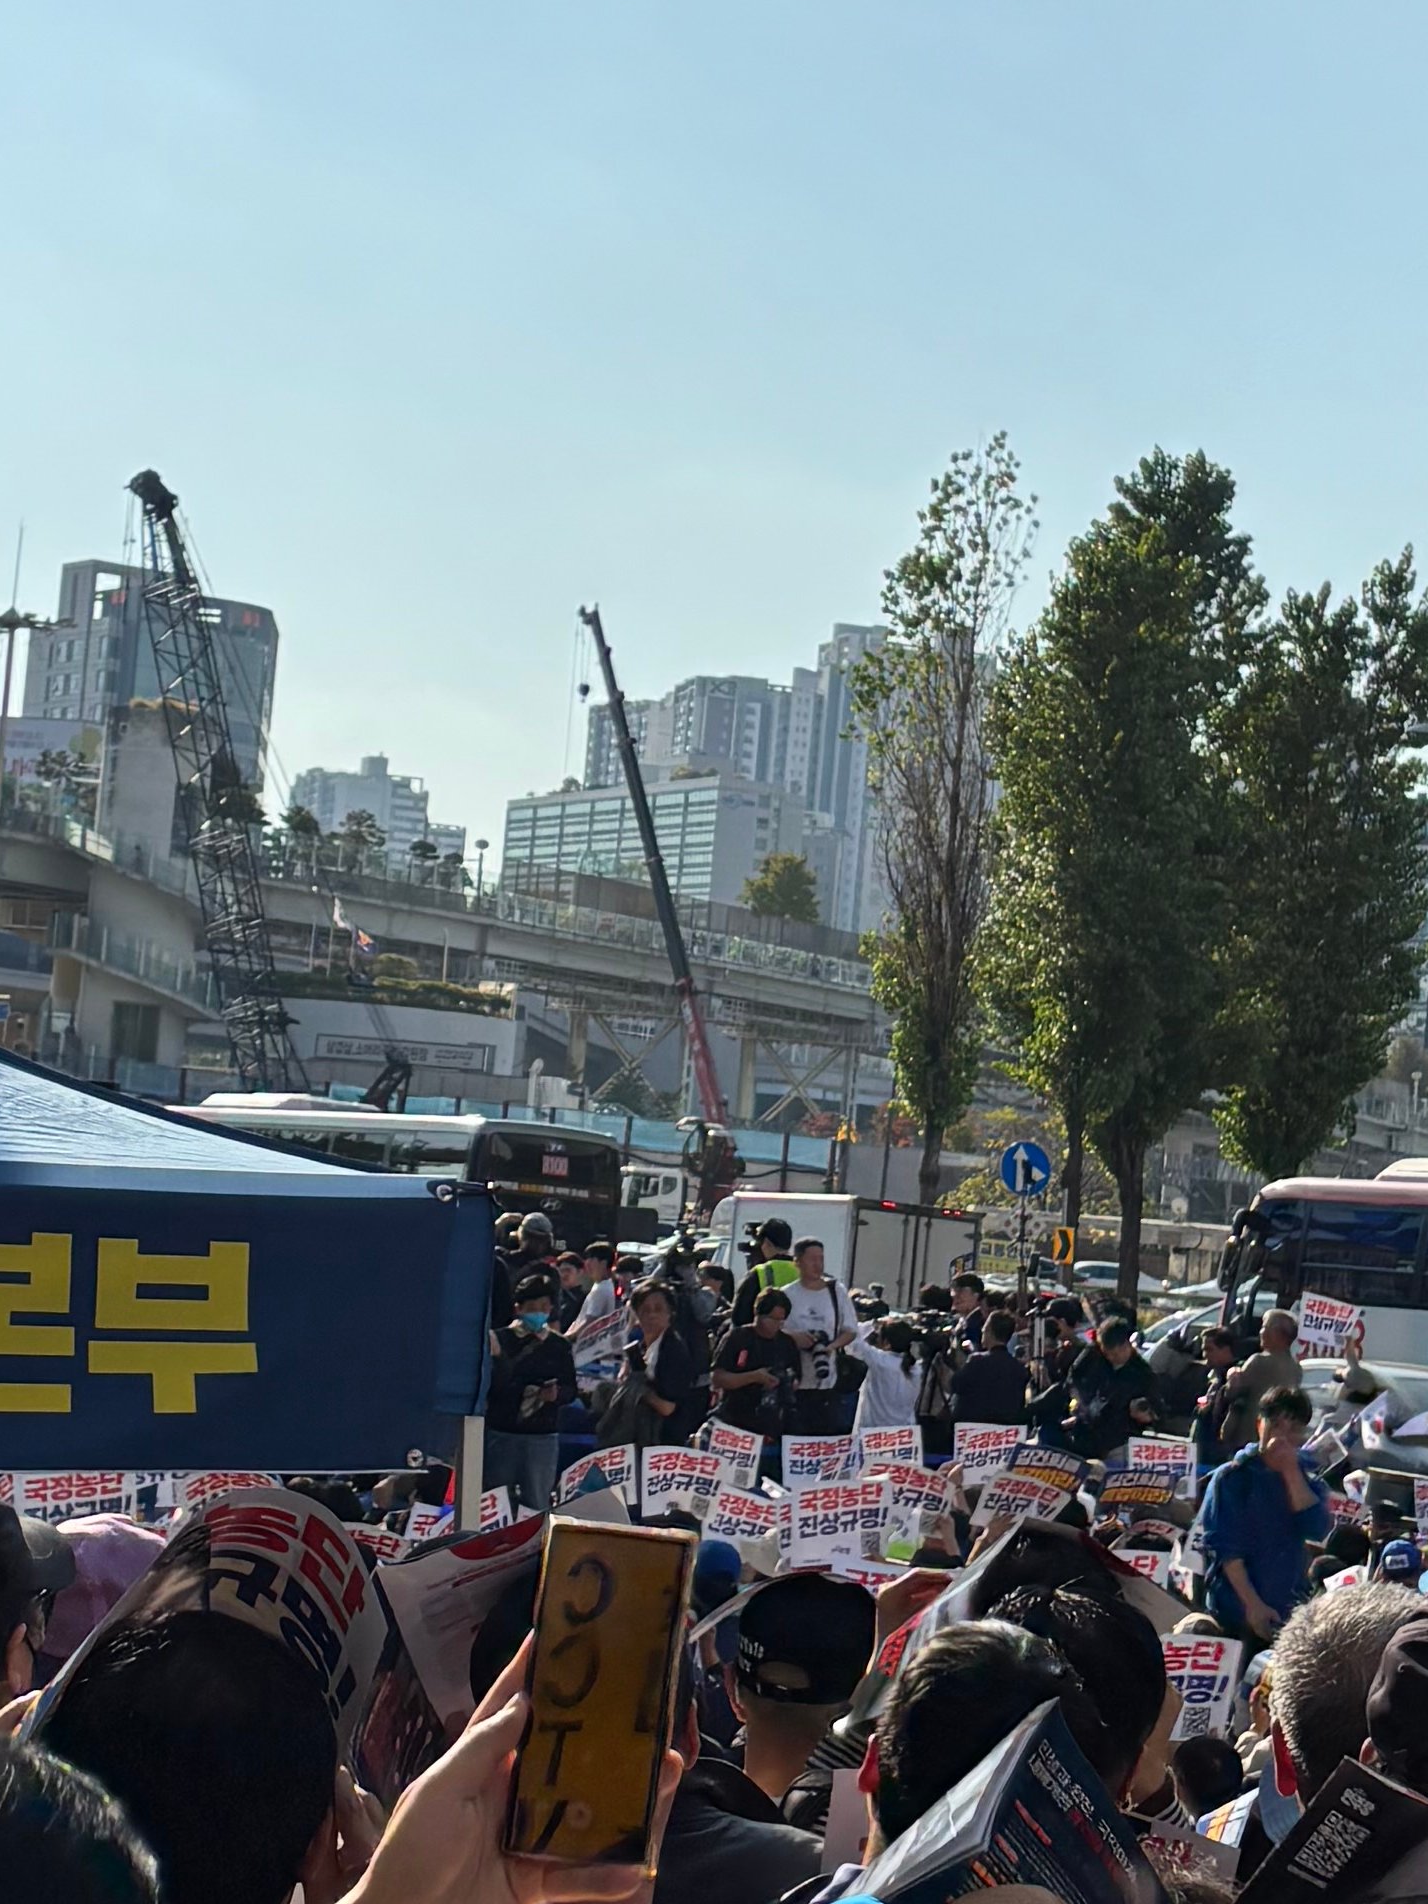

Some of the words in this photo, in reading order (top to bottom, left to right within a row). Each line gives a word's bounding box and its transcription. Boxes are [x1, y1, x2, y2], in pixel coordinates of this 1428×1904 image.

[649, 1453, 720, 1476] 국정농단
[799, 1483, 883, 1512] 국정농단
[799, 1507, 888, 1539] 진상규명!
